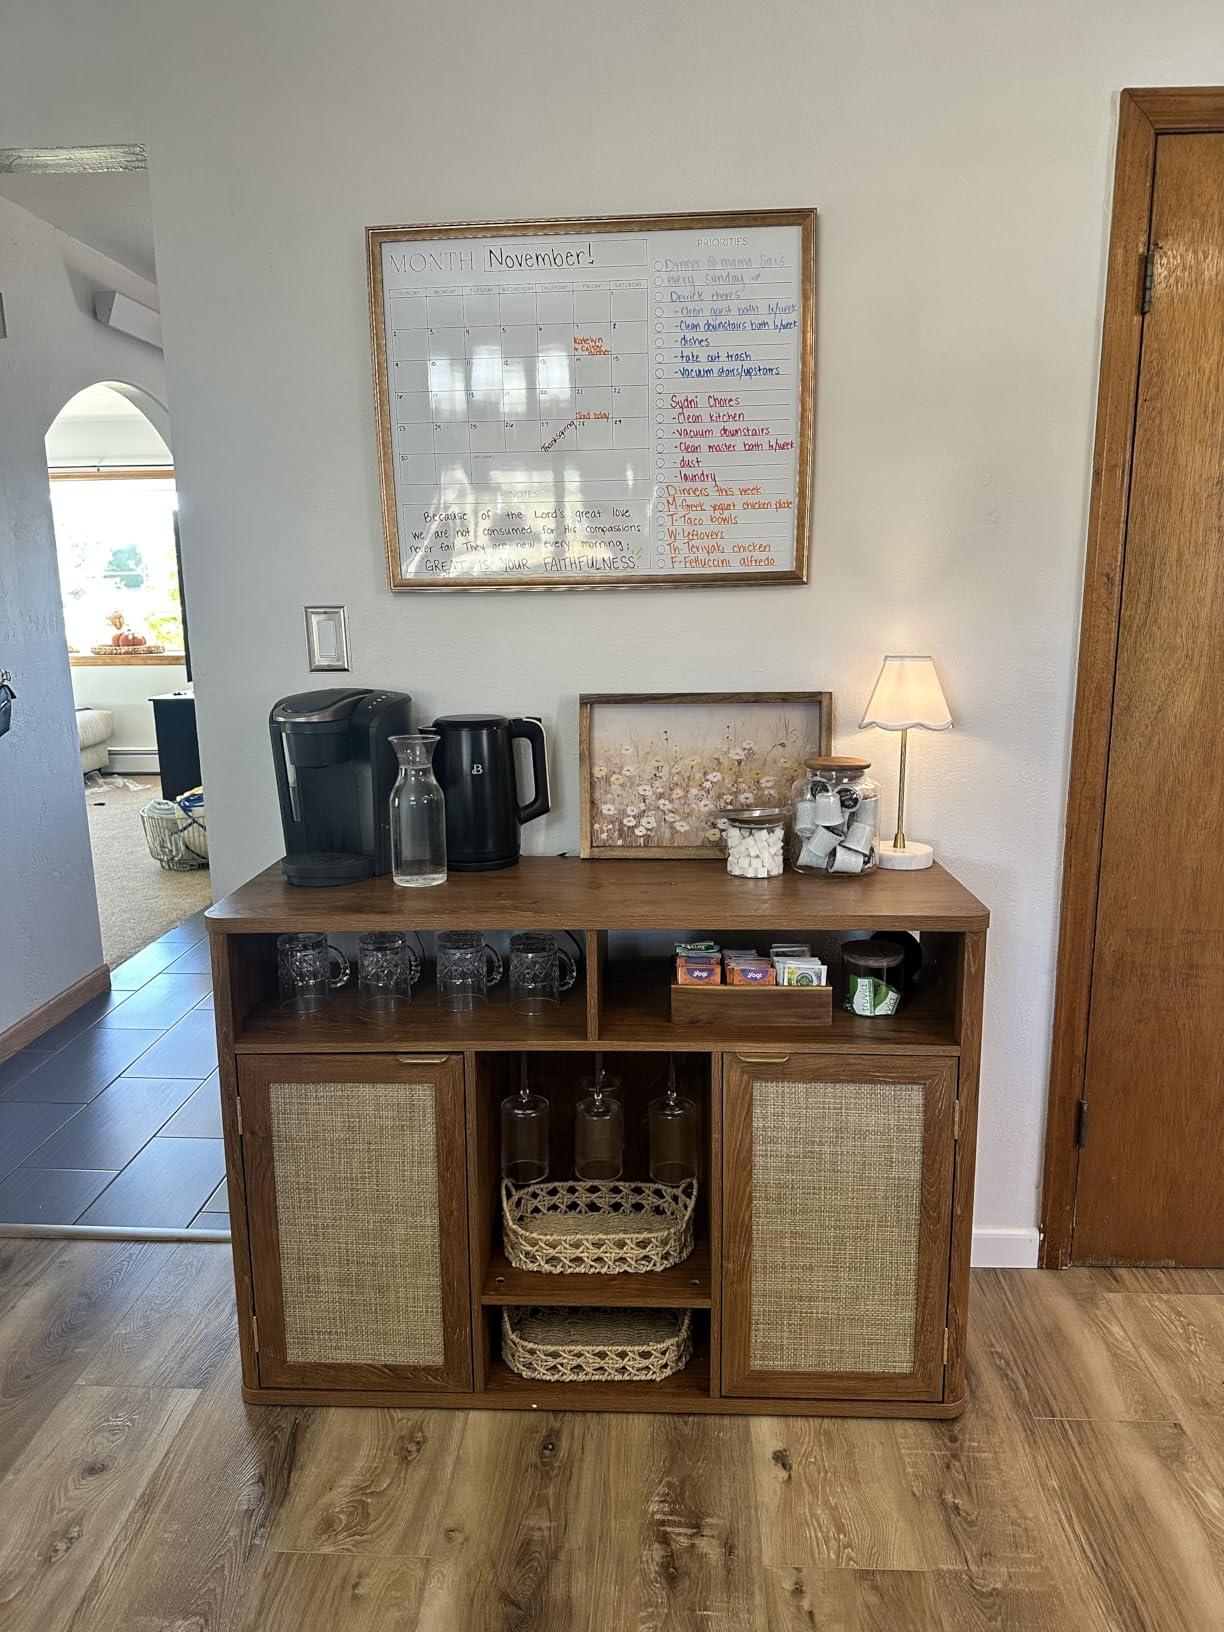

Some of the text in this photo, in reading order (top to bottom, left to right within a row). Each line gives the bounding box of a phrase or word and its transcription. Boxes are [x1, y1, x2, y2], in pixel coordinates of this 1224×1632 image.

[697, 237, 749, 247] PRIORITIES
[489, 242, 595, 269] November!
[390, 251, 474, 273] MONTH
[750, 320, 769, 331] bath
[706, 353, 722, 363] out
[726, 351, 752, 362] trash
[709, 411, 745, 423] kitchen
[720, 425, 771, 437] downstairs
[707, 442, 737, 453] master
[743, 437, 764, 451] bath
[510, 490, 539, 498] NOTES
[666, 484, 762, 497] Dinners this week
[710, 501, 737, 514] yogurt
[742, 500, 772, 510] chicken
[774, 500, 793, 512] plate
[423, 507, 631, 523] Because of the Lord's great love
[710, 514, 738, 525] bowls
[434, 530, 449, 539] are
[456, 527, 471, 538] not
[542, 525, 556, 535] for
[585, 524, 641, 535] compassions
[461, 541, 486, 554] They
[492, 542, 507, 550] are
[516, 541, 535, 549] new
[543, 540, 570, 551] every
[732, 543, 771, 553] chicken
[425, 559, 467, 572] GREAT
[479, 560, 490, 571] IS
[501, 558, 530, 572] YOUR
[739, 556, 775, 567] alfredo
[471, 764, 483, 775] B
